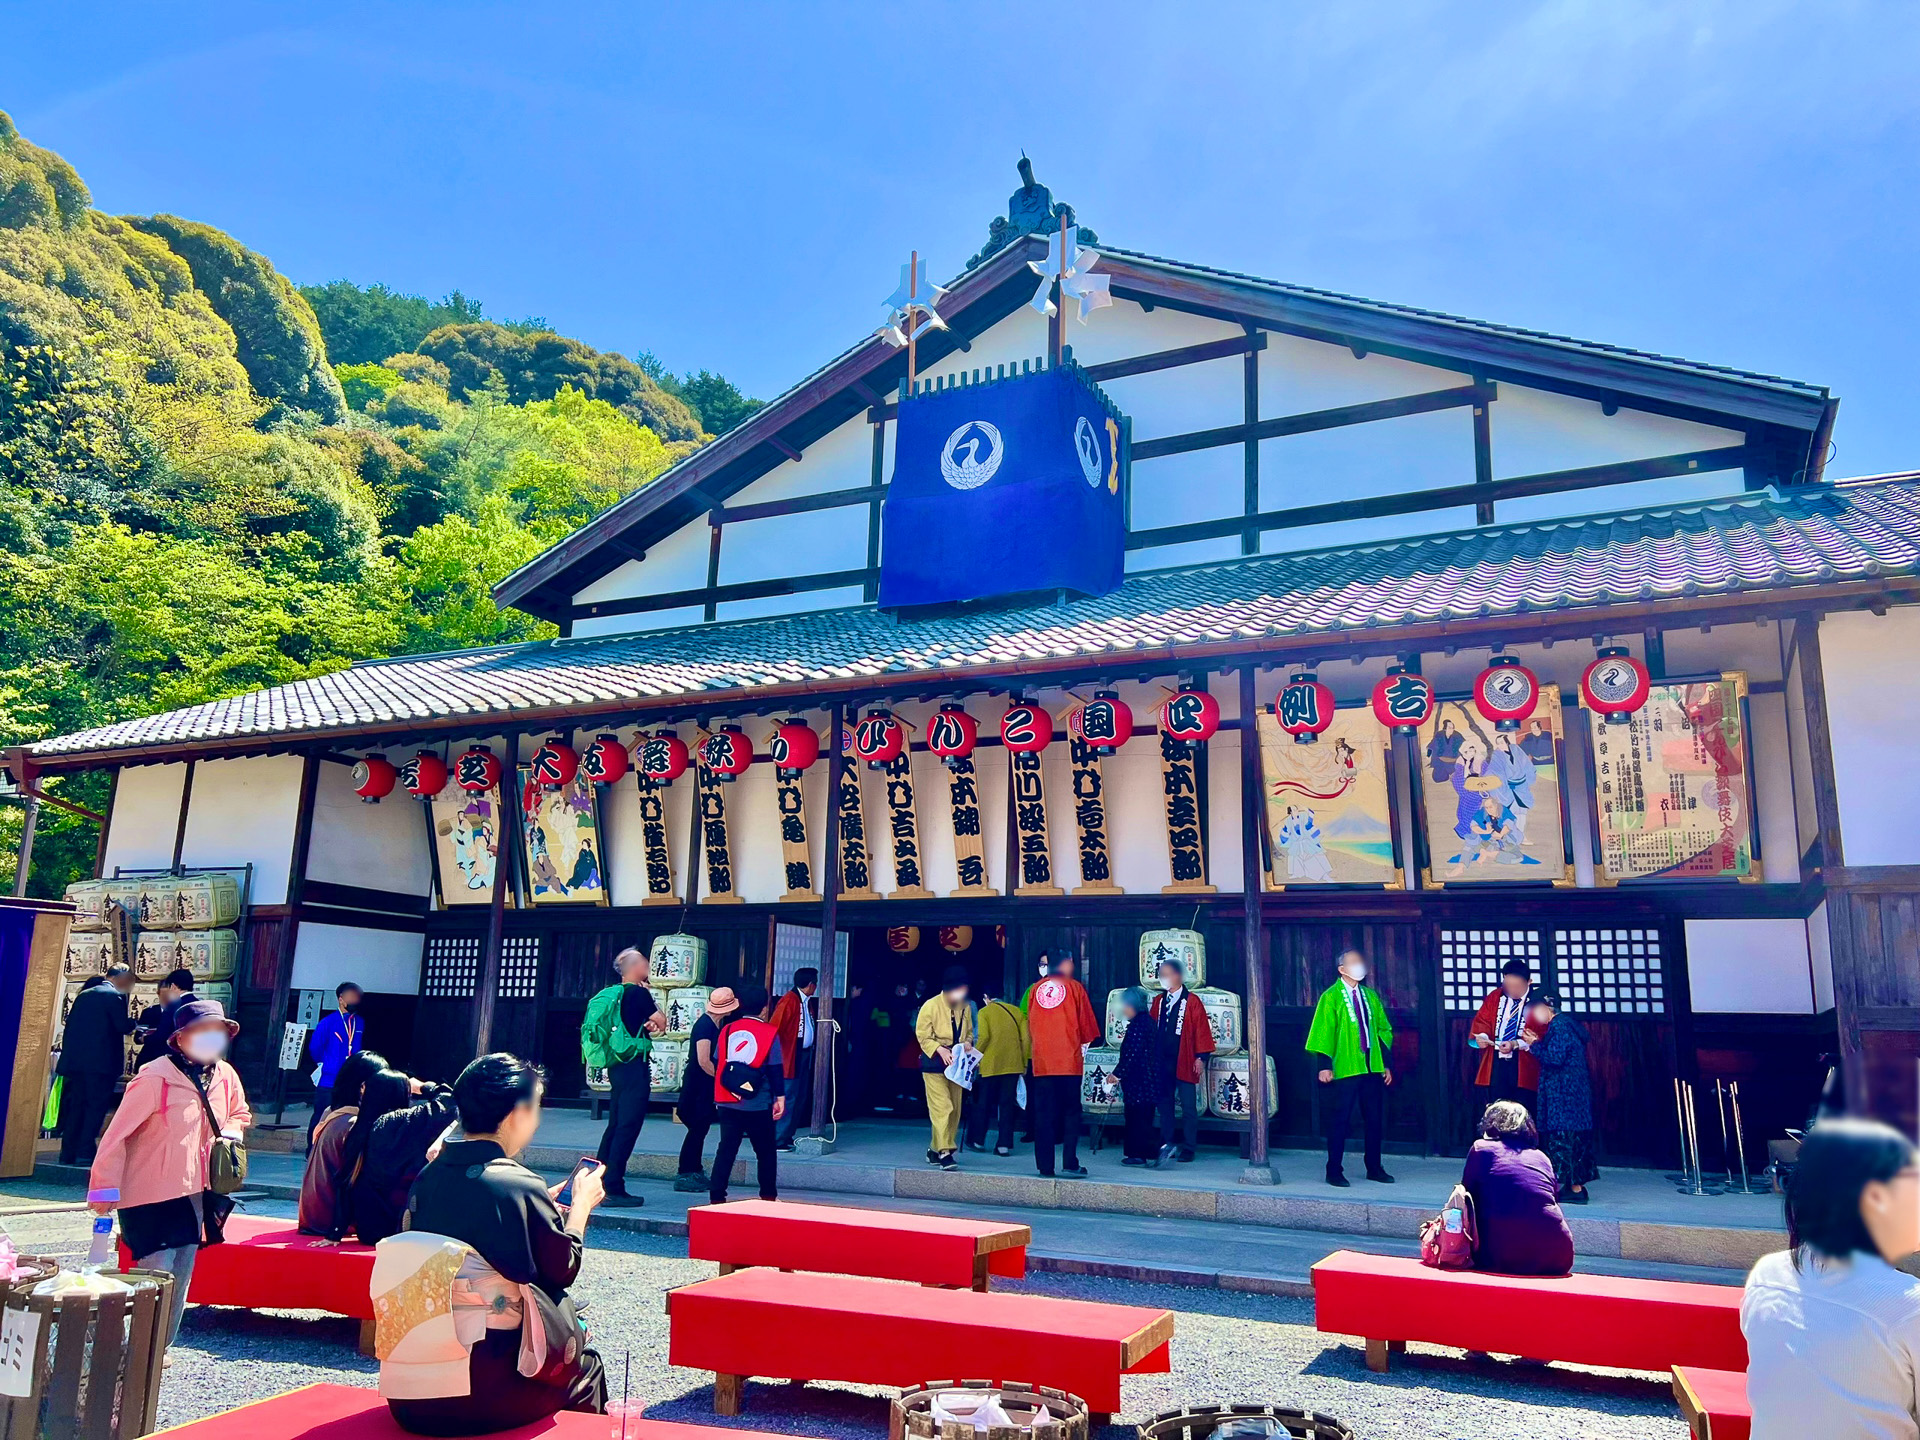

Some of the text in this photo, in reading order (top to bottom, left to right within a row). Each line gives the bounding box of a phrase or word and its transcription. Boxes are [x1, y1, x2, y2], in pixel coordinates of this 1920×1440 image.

[1167, 694, 1205, 734] 四
[1278, 683, 1320, 727] 例
[1384, 675, 1429, 720] 吉
[855, 719, 895, 755] ぴ
[929, 713, 965, 751] ん
[1003, 708, 1036, 745] こ
[457, 753, 491, 788] 芝
[531, 745, 562, 780] 大
[641, 738, 671, 774] 舞
[656, 945, 674, 978] 金陵
[669, 999, 685, 1032] 金陵
[1224, 1072, 1247, 1113] 金陵
